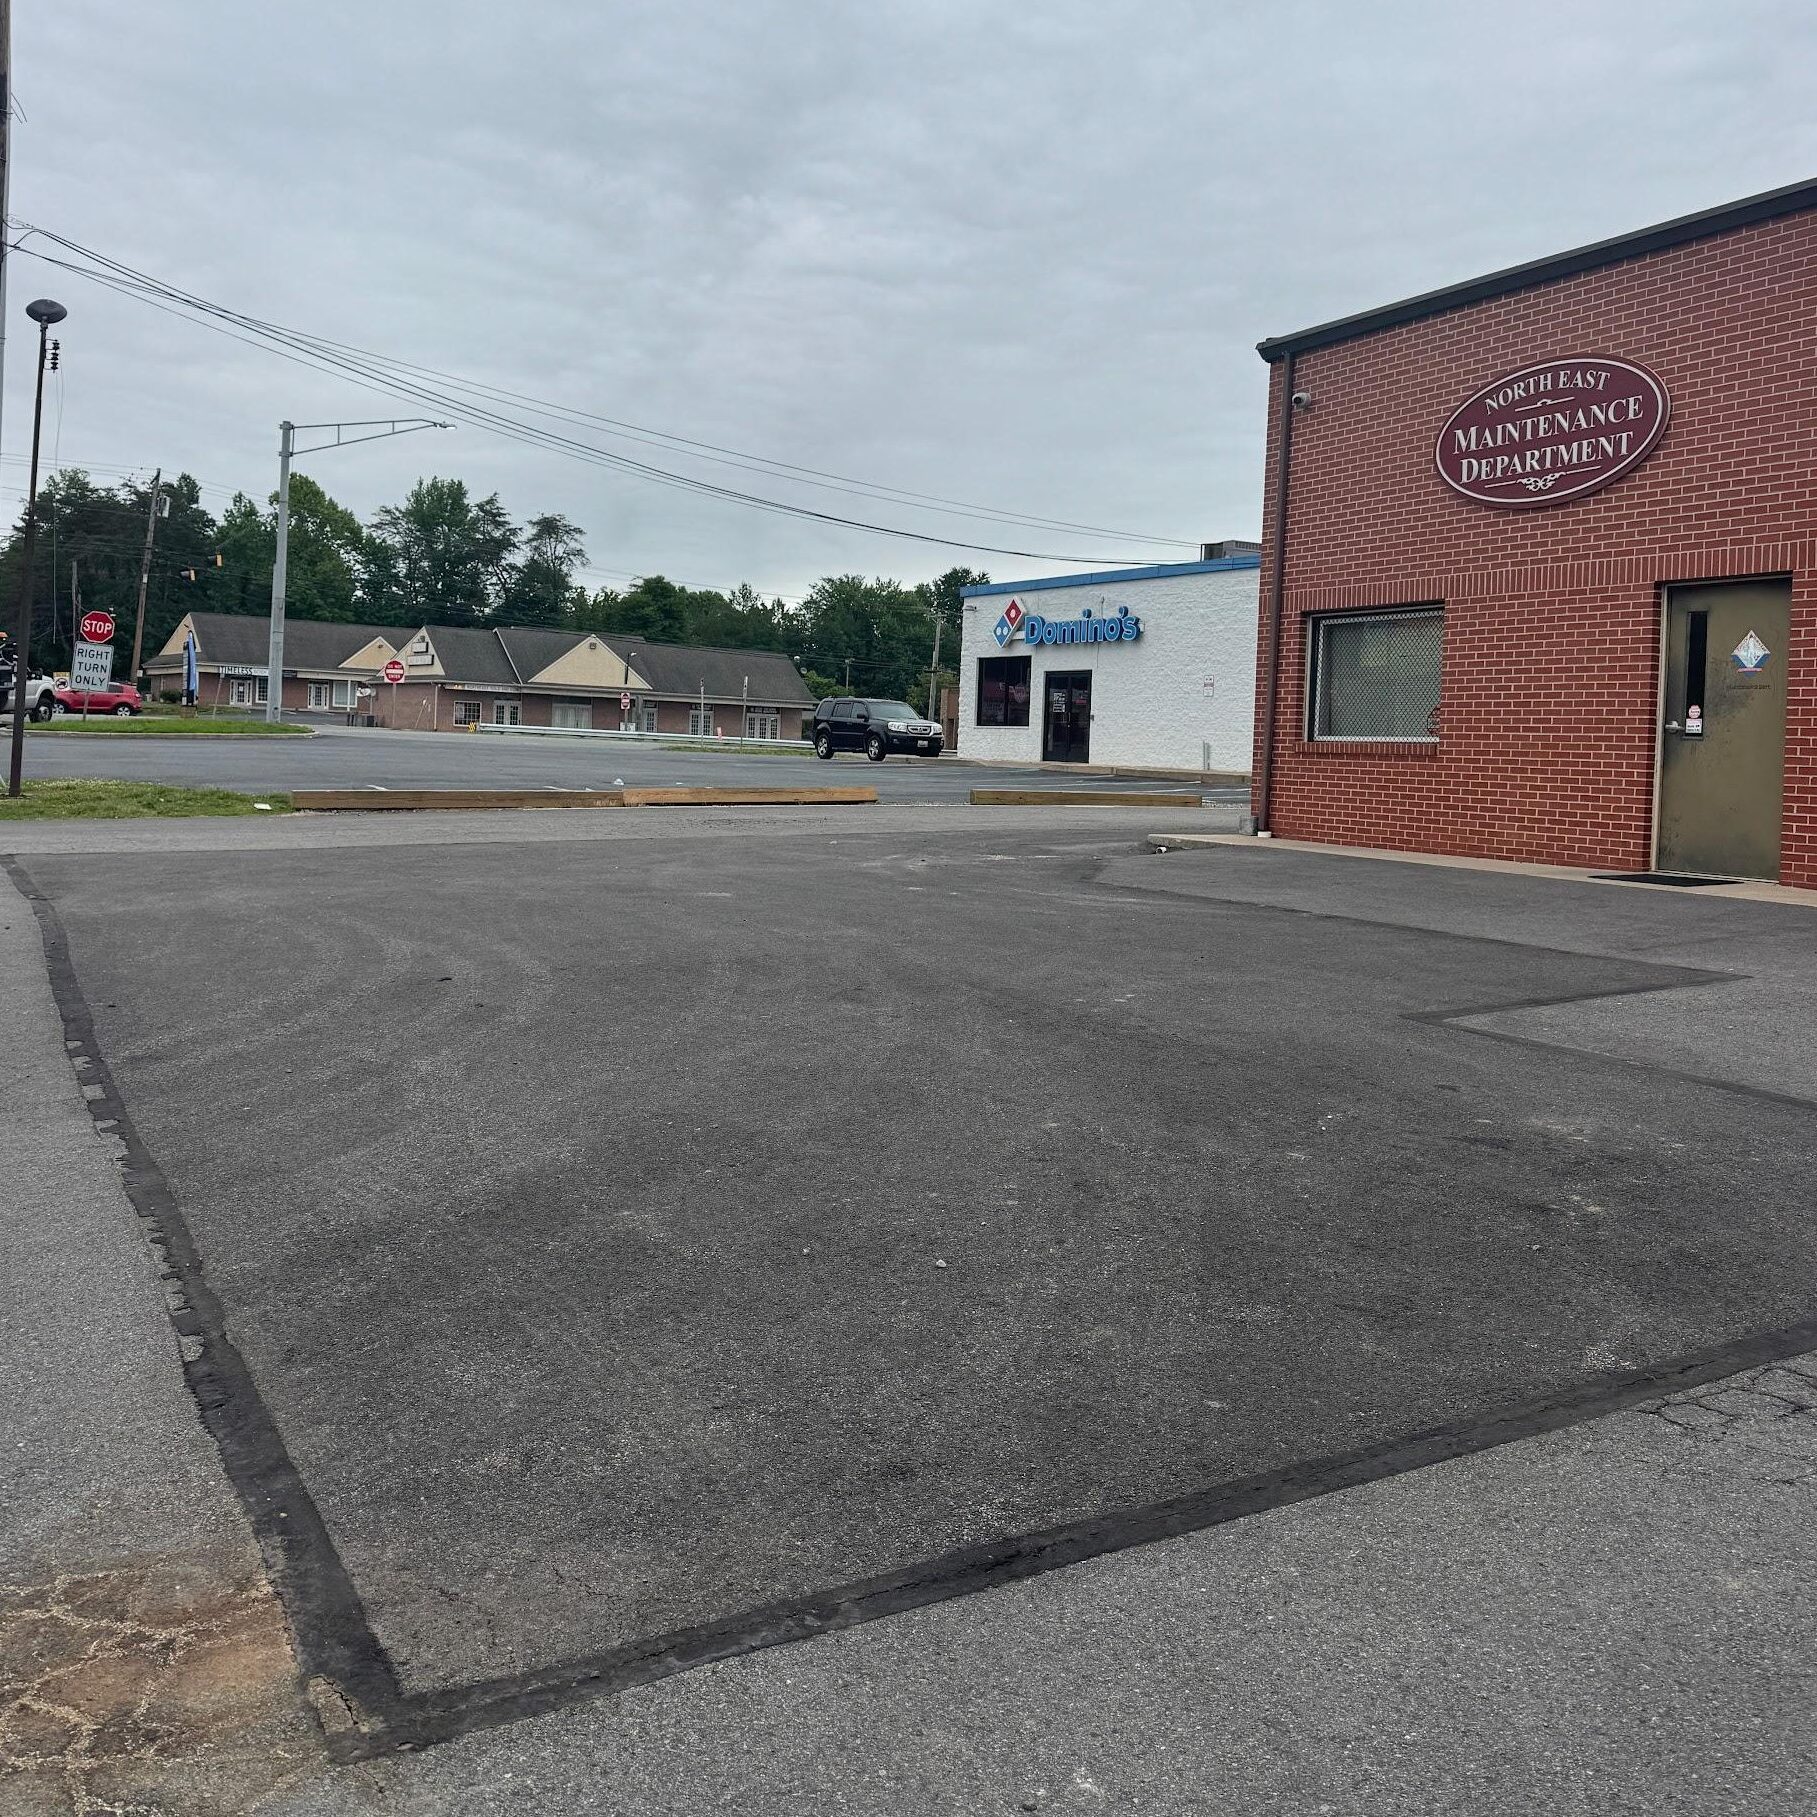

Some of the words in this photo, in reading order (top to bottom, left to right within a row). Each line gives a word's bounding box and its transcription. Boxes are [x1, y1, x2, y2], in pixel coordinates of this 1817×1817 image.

[1484, 372, 1552, 415] NORTH
[1558, 370, 1611, 391] EAST
[1452, 395, 1644, 455] MAINTENANCE
[1459, 431, 1634, 484] DEPARTMENT
[83, 619, 113, 634] STOP
[1024, 606, 1140, 645] Domino's
[77, 648, 110, 661] RIGHT
[78, 661, 108, 673] TURN
[219, 665, 253, 676] TIMELESS
[75, 675, 105, 686] ONLY
